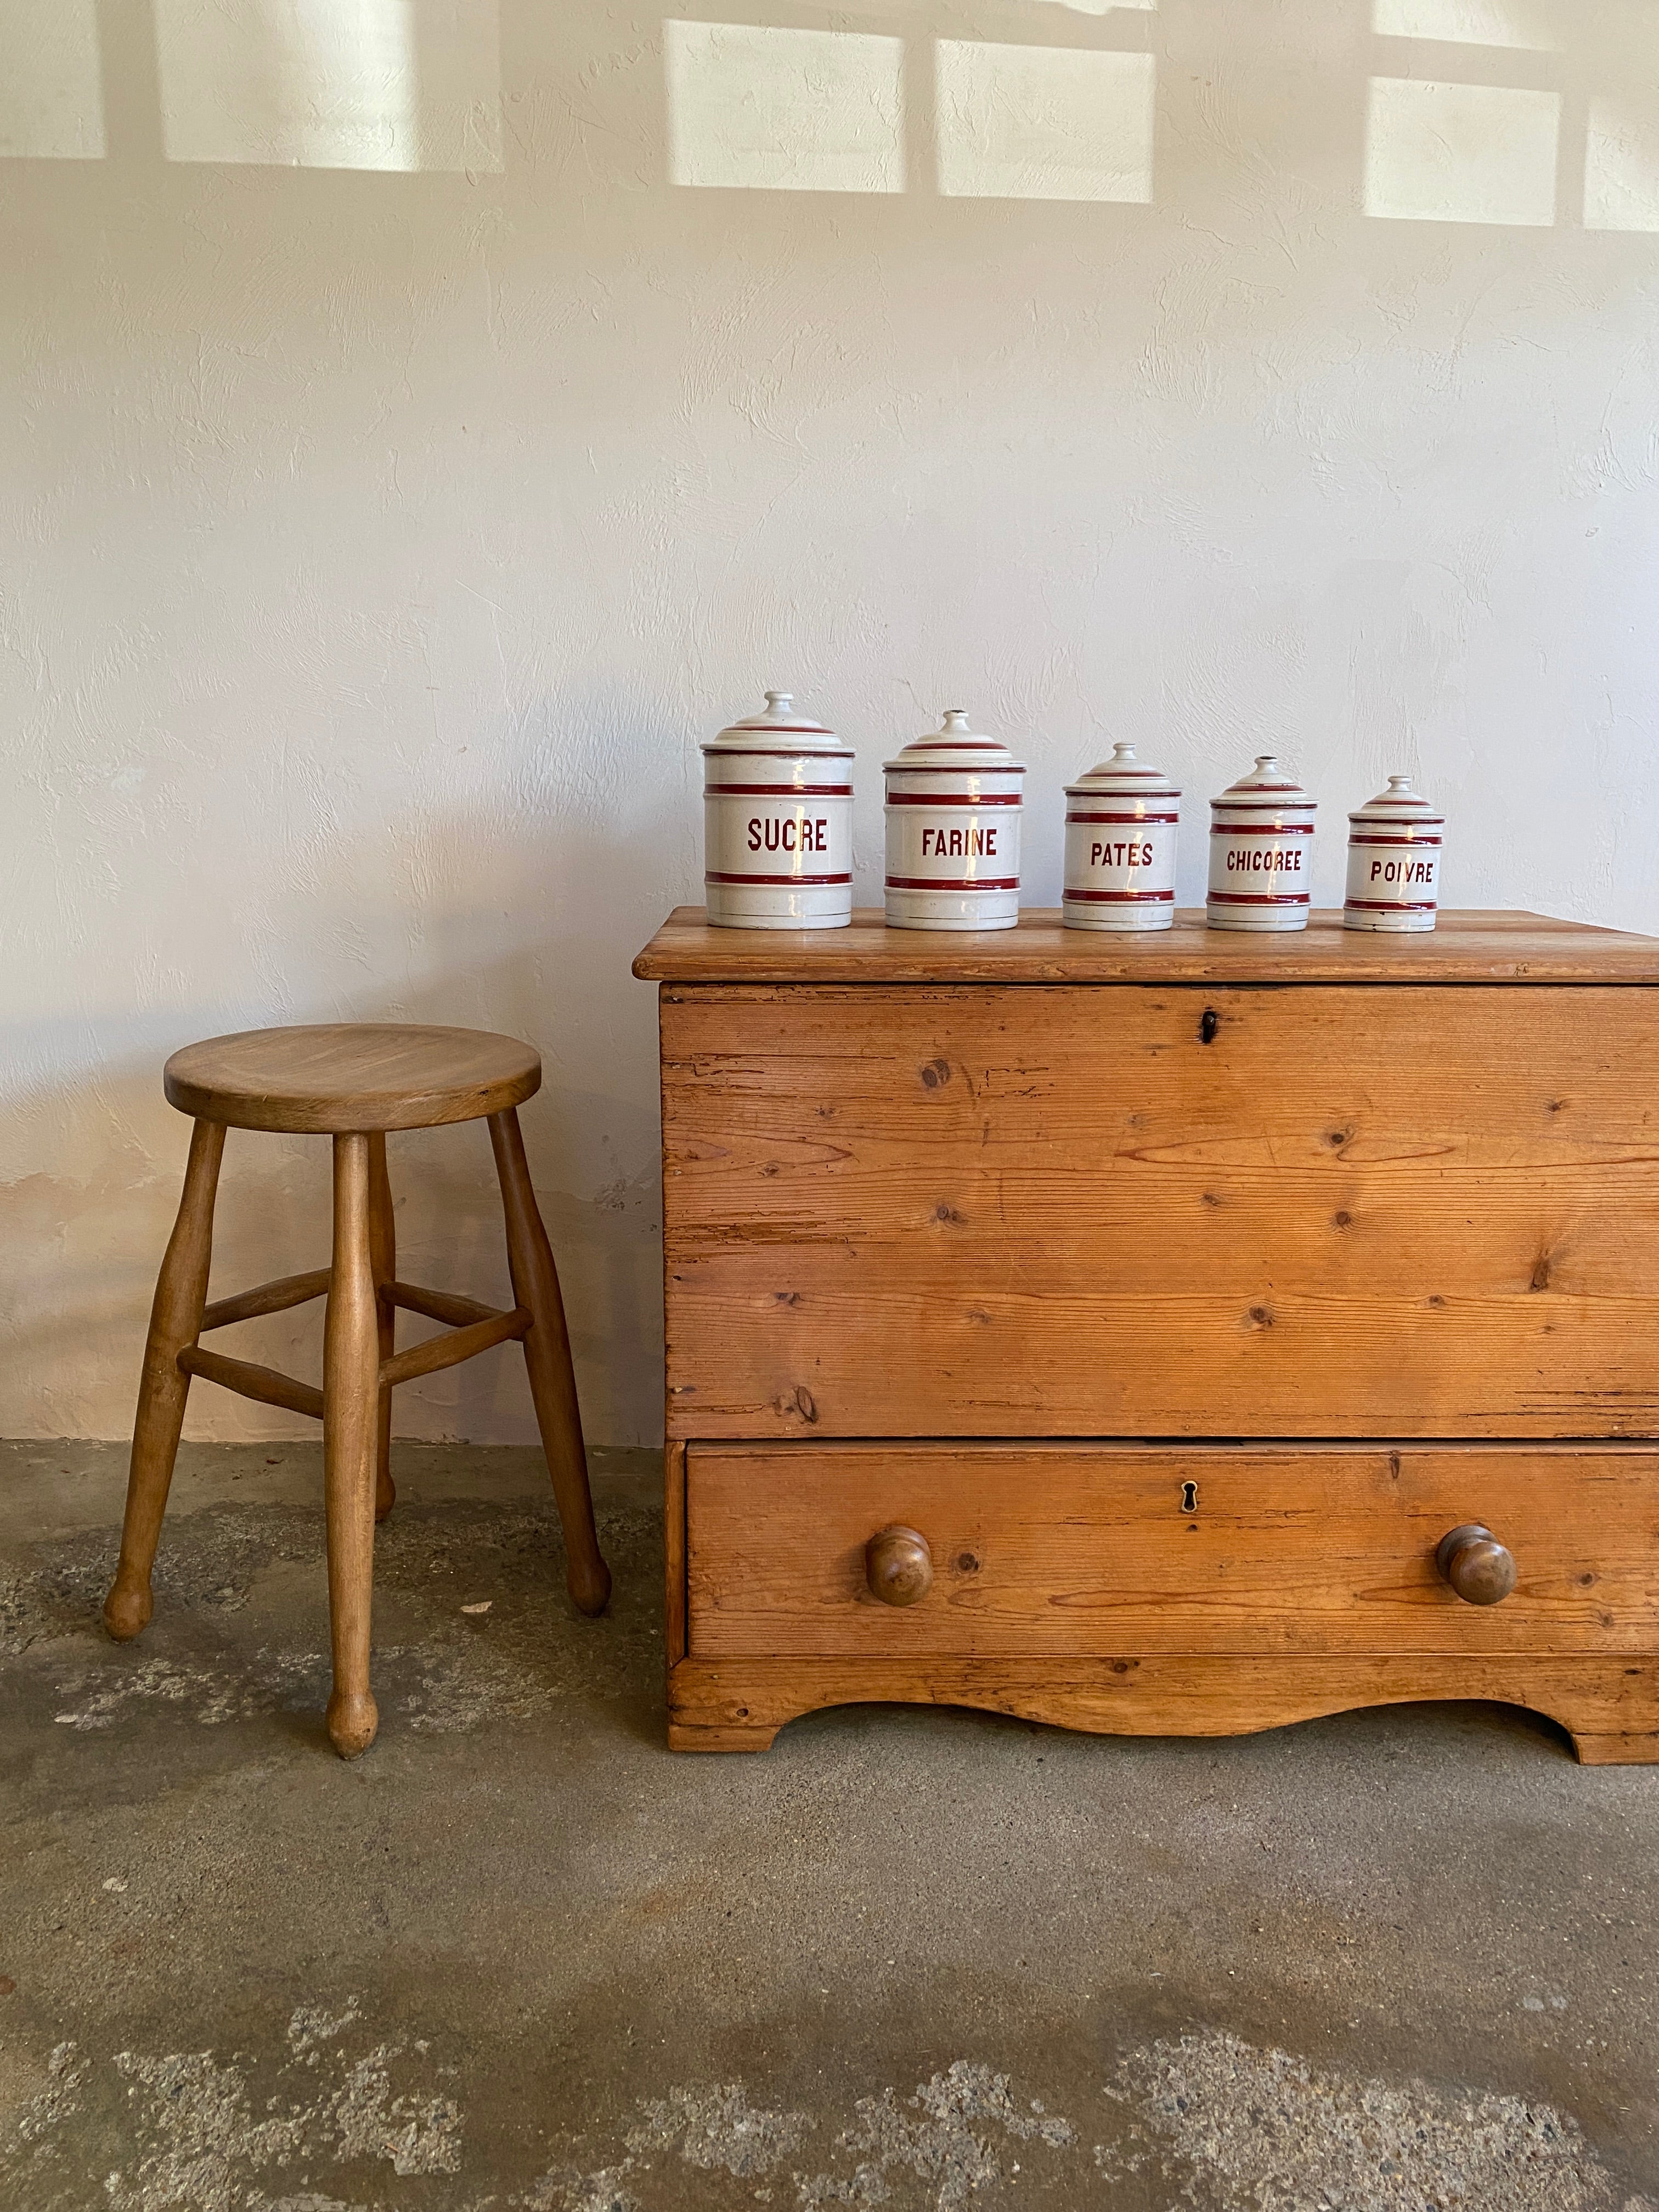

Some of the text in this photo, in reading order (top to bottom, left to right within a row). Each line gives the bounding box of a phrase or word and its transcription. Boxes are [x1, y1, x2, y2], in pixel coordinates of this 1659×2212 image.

[747, 819, 827, 851] SUCRE
[922, 829, 997, 856] FARINE
[1091, 843, 1153, 867] PATES
[1227, 850, 1302, 872] CHICOREE
[1370, 861, 1434, 883] POIVRE
